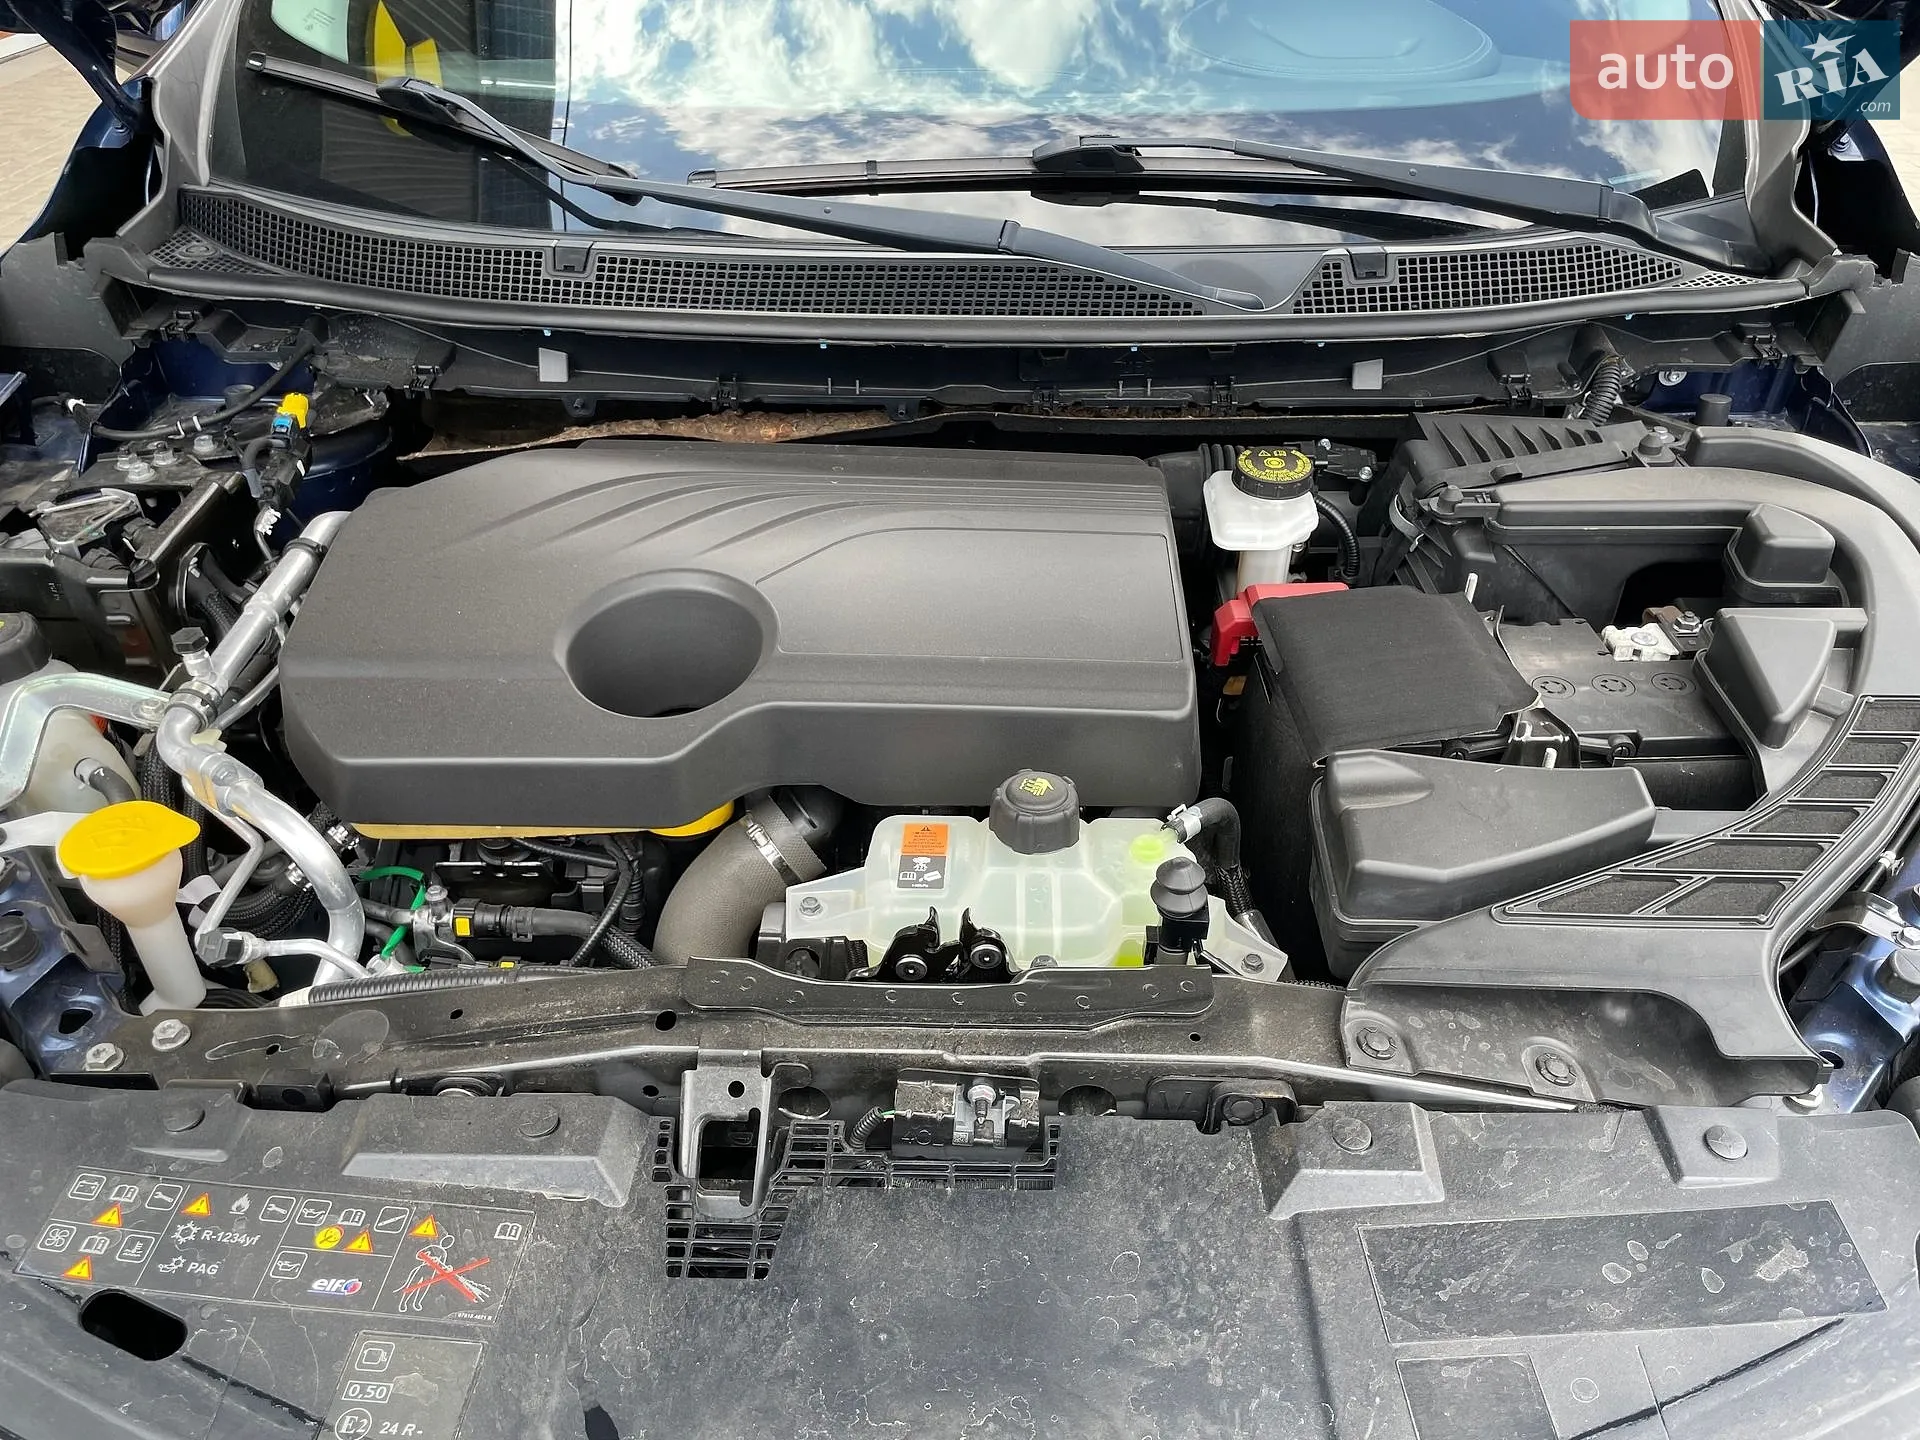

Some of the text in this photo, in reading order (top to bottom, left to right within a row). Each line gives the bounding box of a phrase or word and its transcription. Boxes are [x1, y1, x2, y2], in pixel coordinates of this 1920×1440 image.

[201, 1229, 261, 1247] R-1234yf
[186, 1262, 219, 1275] PAG
[348, 1384, 388, 1399] 0,50
[379, 1421, 400, 1435] 24
